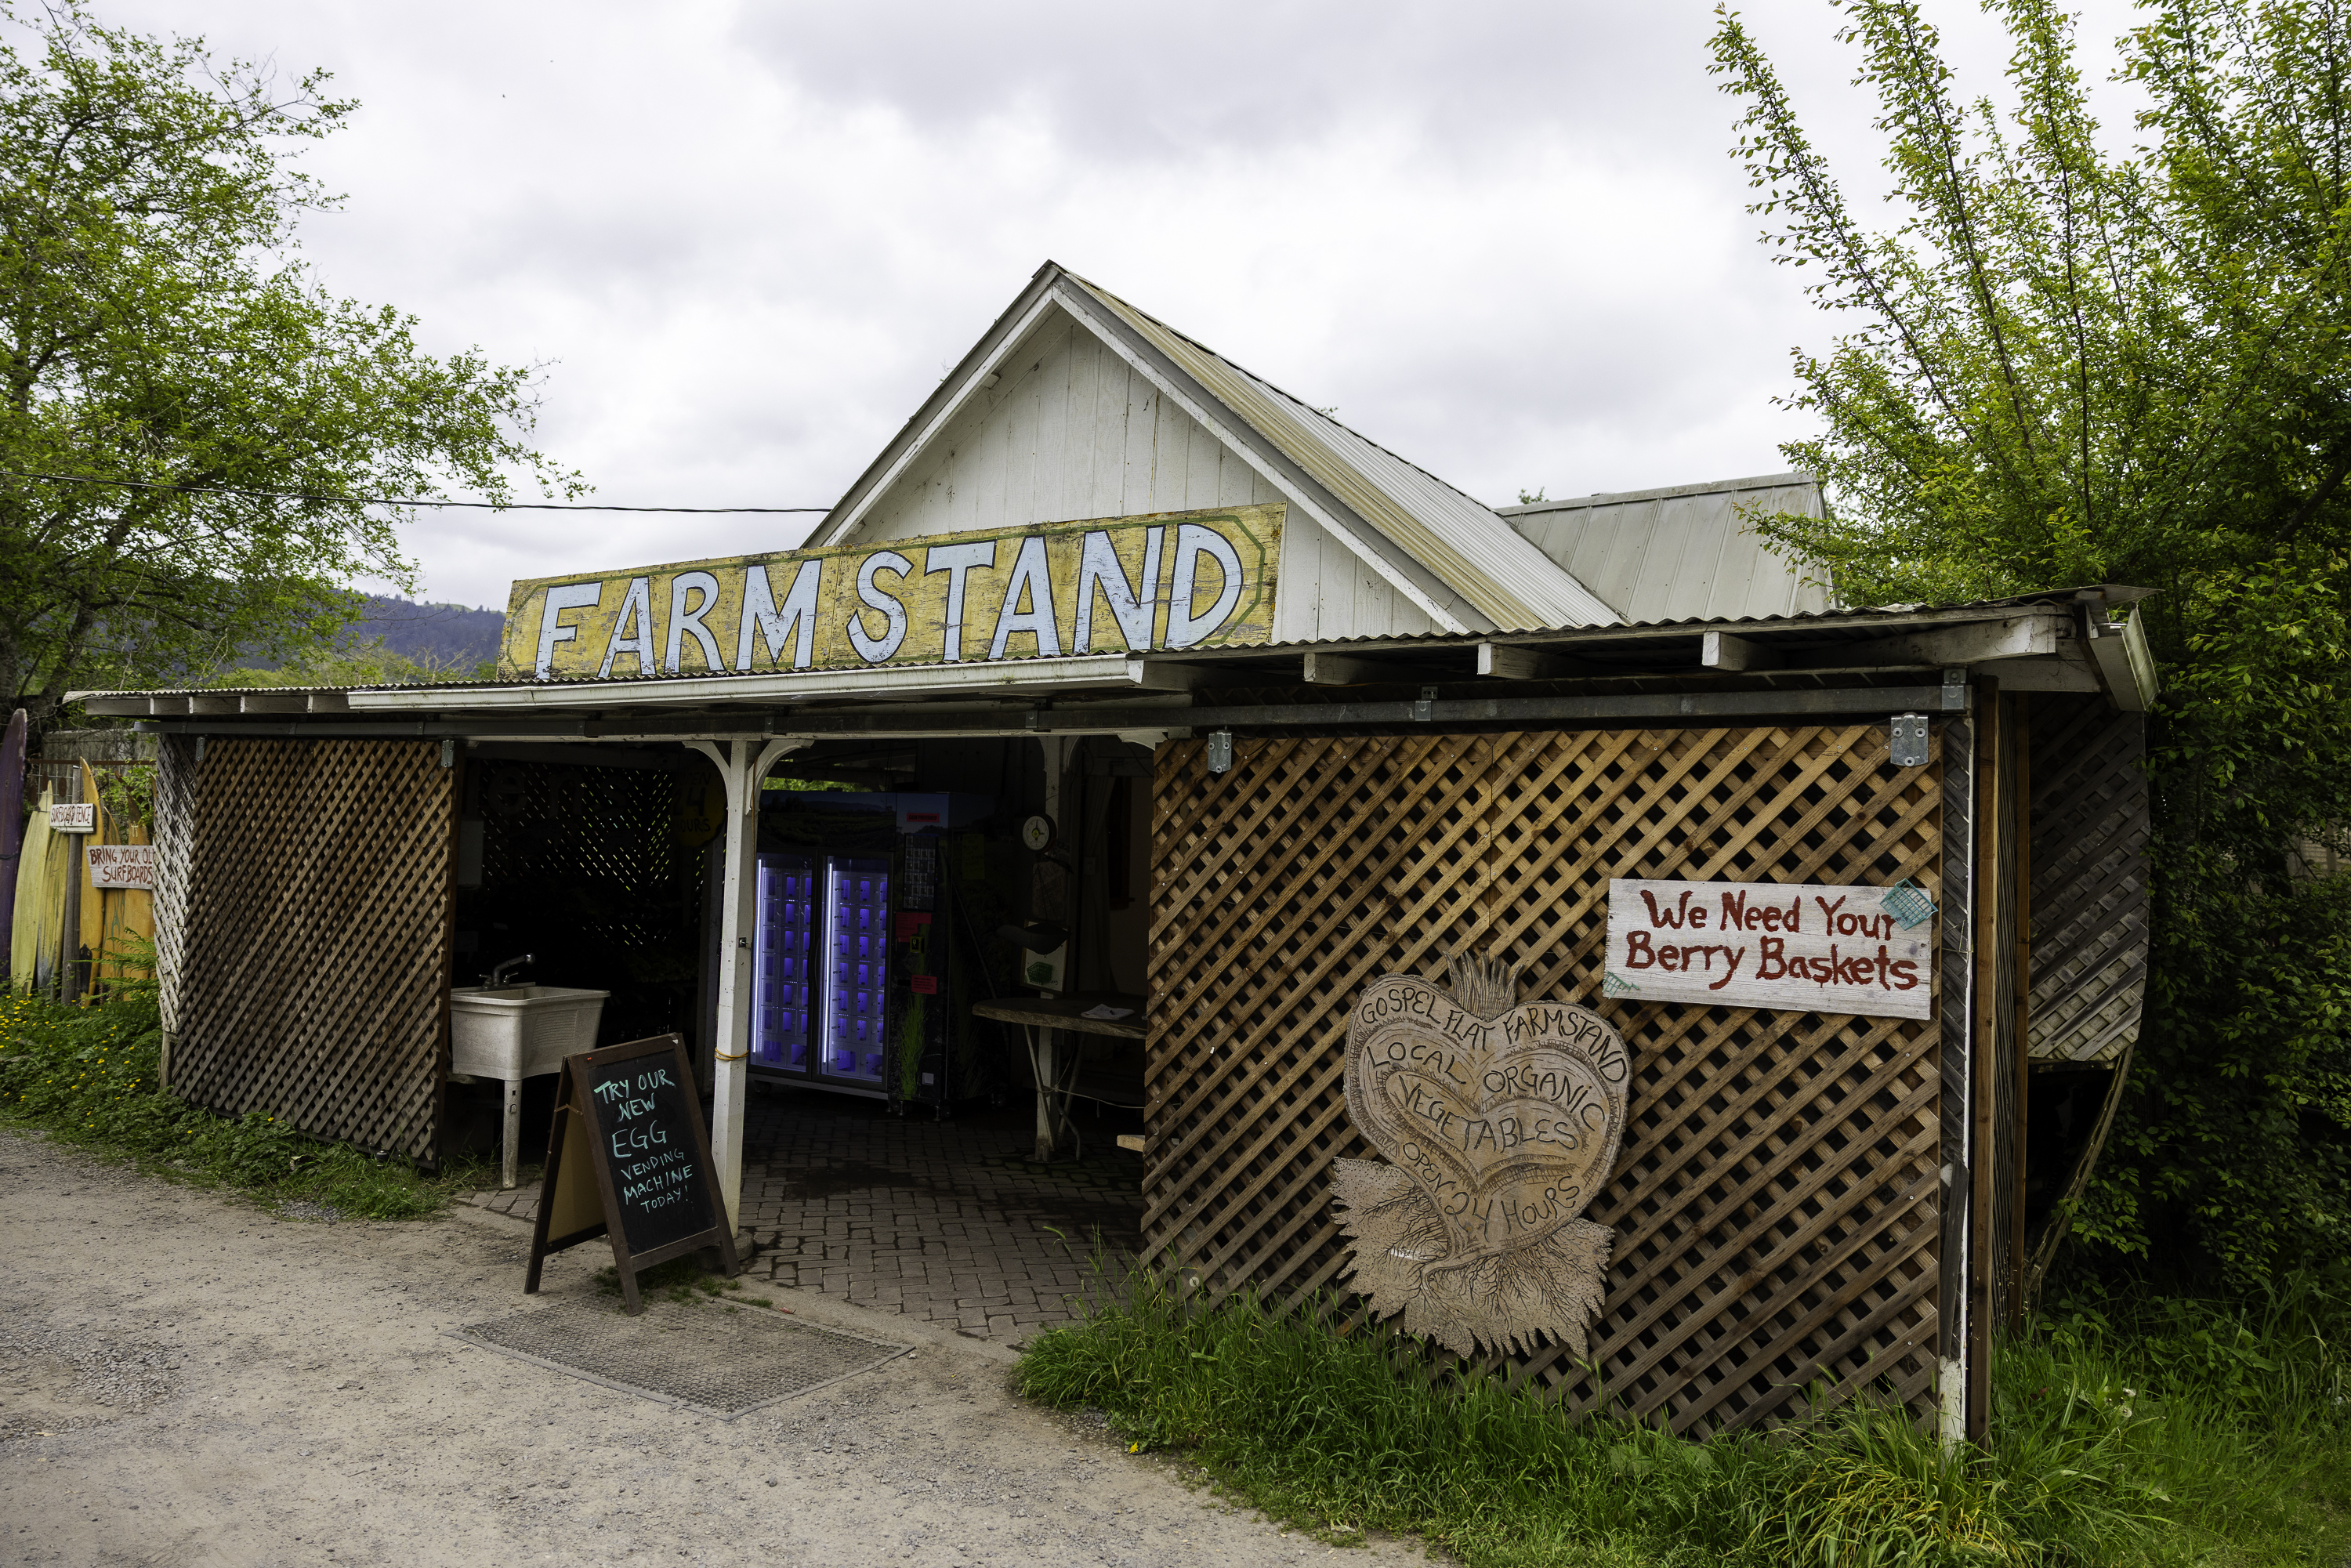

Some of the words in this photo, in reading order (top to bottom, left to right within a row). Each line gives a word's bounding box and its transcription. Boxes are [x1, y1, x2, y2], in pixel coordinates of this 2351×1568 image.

[846, 523, 1244, 664] STAND
[76, 806, 91, 824] FENCE
[672, 787, 706, 816] 24
[89, 848, 117, 866] BRING
[121, 848, 140, 864] YOUR
[102, 865, 153, 885] SURFBOARDS
[1640, 889, 1707, 930] We
[1720, 889, 1801, 932] Need
[1815, 895, 1897, 941] Your
[1625, 930, 1745, 990] Berry
[1755, 936, 1918, 990] Baskets
[1361, 987, 1441, 1026] GOSPEL
[1444, 1010, 1494, 1051] FLAT
[1502, 1008, 1628, 1083] FARMSTAND
[594, 1080, 629, 1104] TRY
[638, 1069, 676, 1089] OUR
[1365, 1041, 1467, 1085] LOCAL
[1483, 1064, 1605, 1131] ORGANIC
[617, 1092, 655, 1123] NEW
[1398, 1074, 1578, 1153] VEGETABLES
[611, 1120, 666, 1158] EGG
[621, 1148, 684, 1180] VENDING
[624, 1164, 693, 1205] MACHINE
[640, 1185, 688, 1213] TODAY!
[1403, 1142, 1455, 1197] OPEN
[1444, 1192, 1493, 1242] 24
[1500, 1175, 1580, 1234] HOURS
